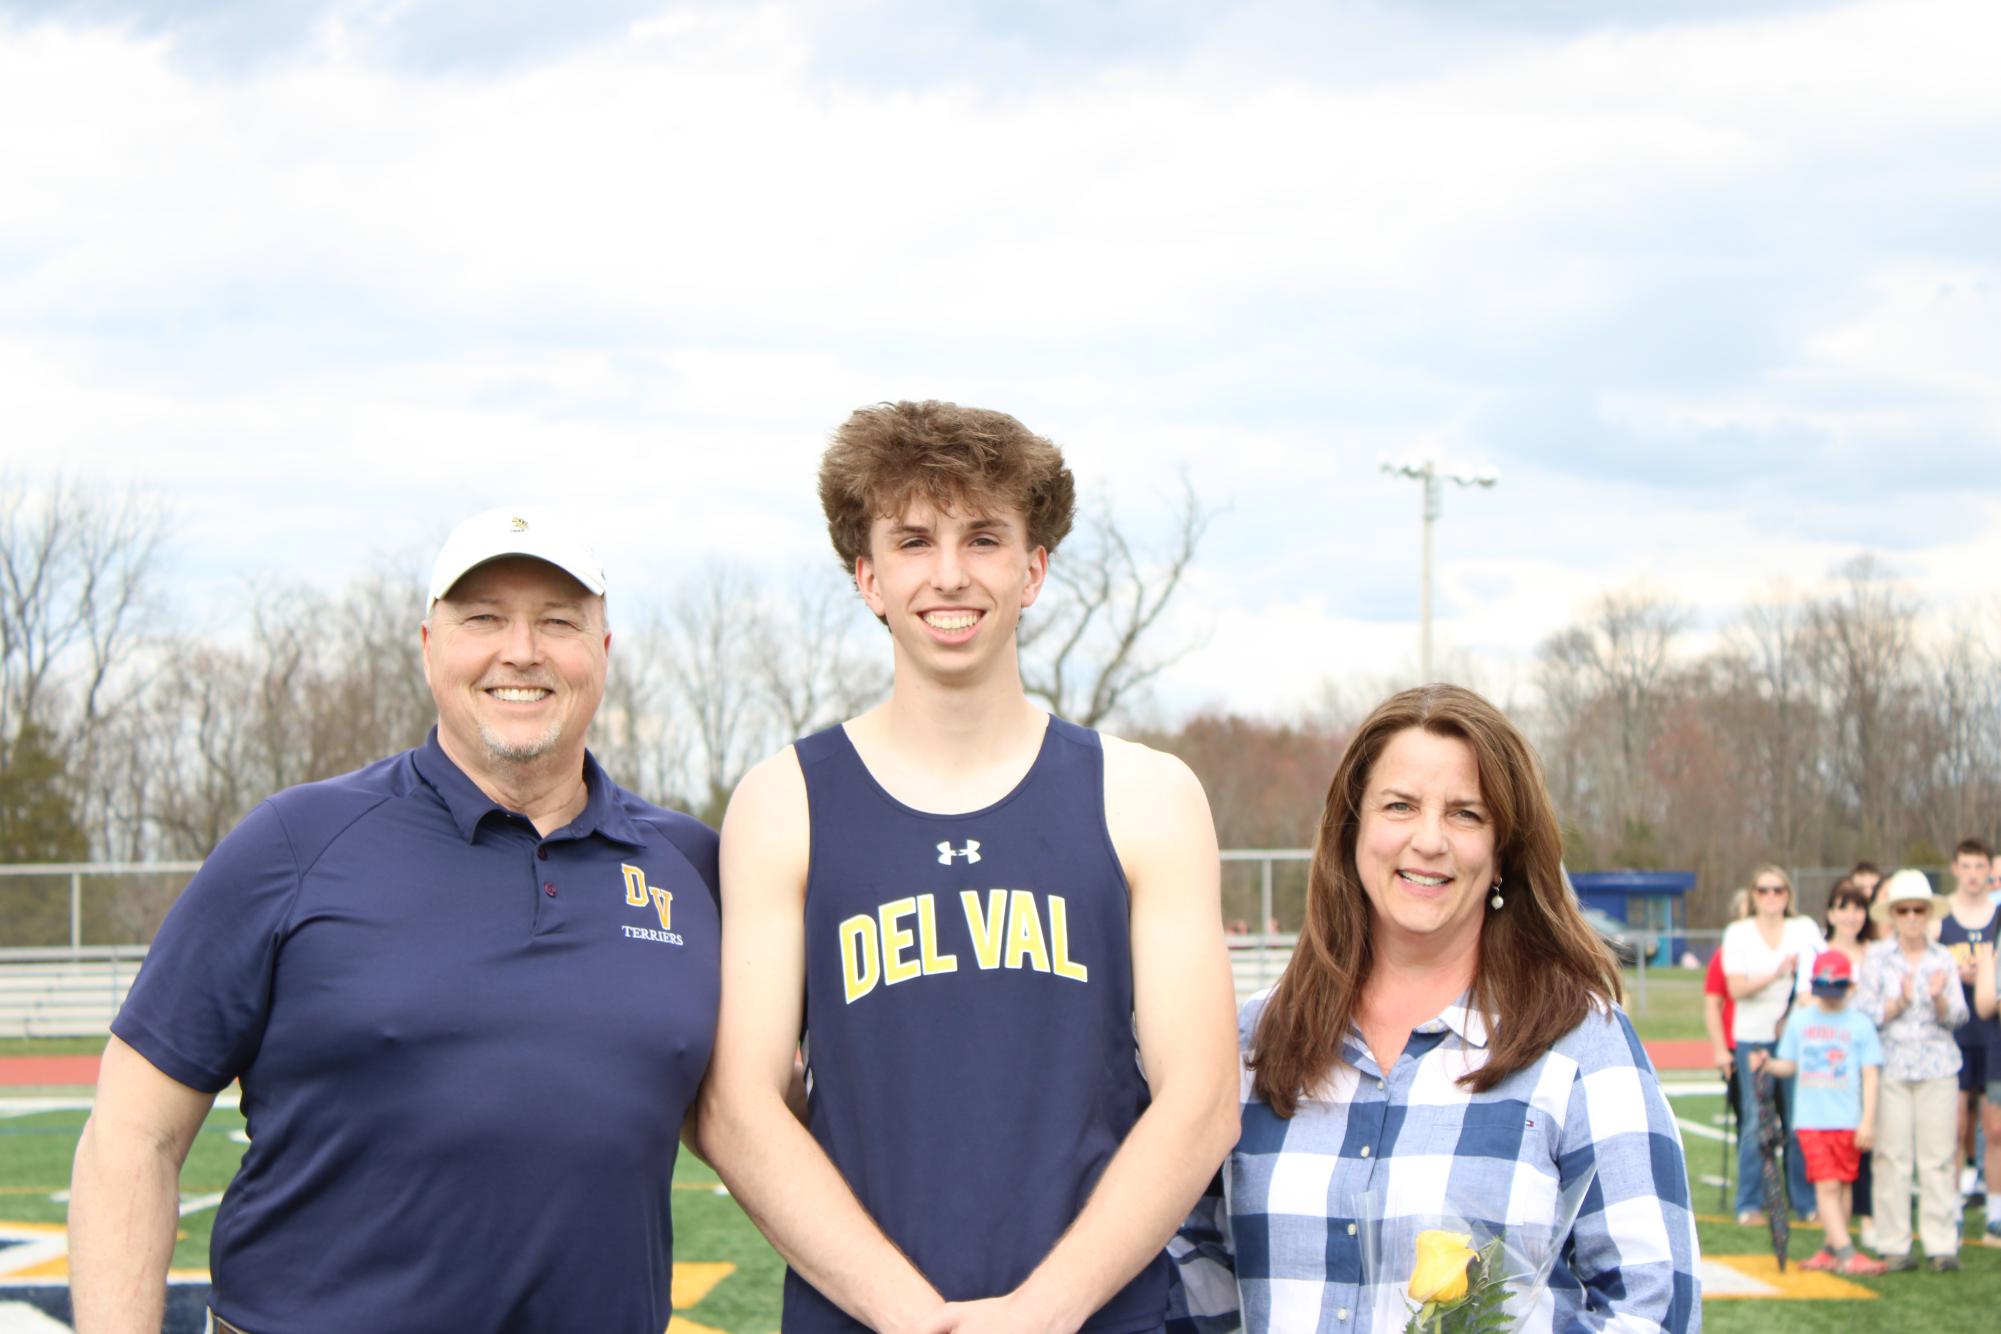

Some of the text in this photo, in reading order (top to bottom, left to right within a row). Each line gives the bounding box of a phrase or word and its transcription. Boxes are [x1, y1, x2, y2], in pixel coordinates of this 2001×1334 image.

[621, 863, 673, 931] DV
[621, 925, 684, 946] TERRIERS
[839, 889, 1088, 1005] DEL VAL
